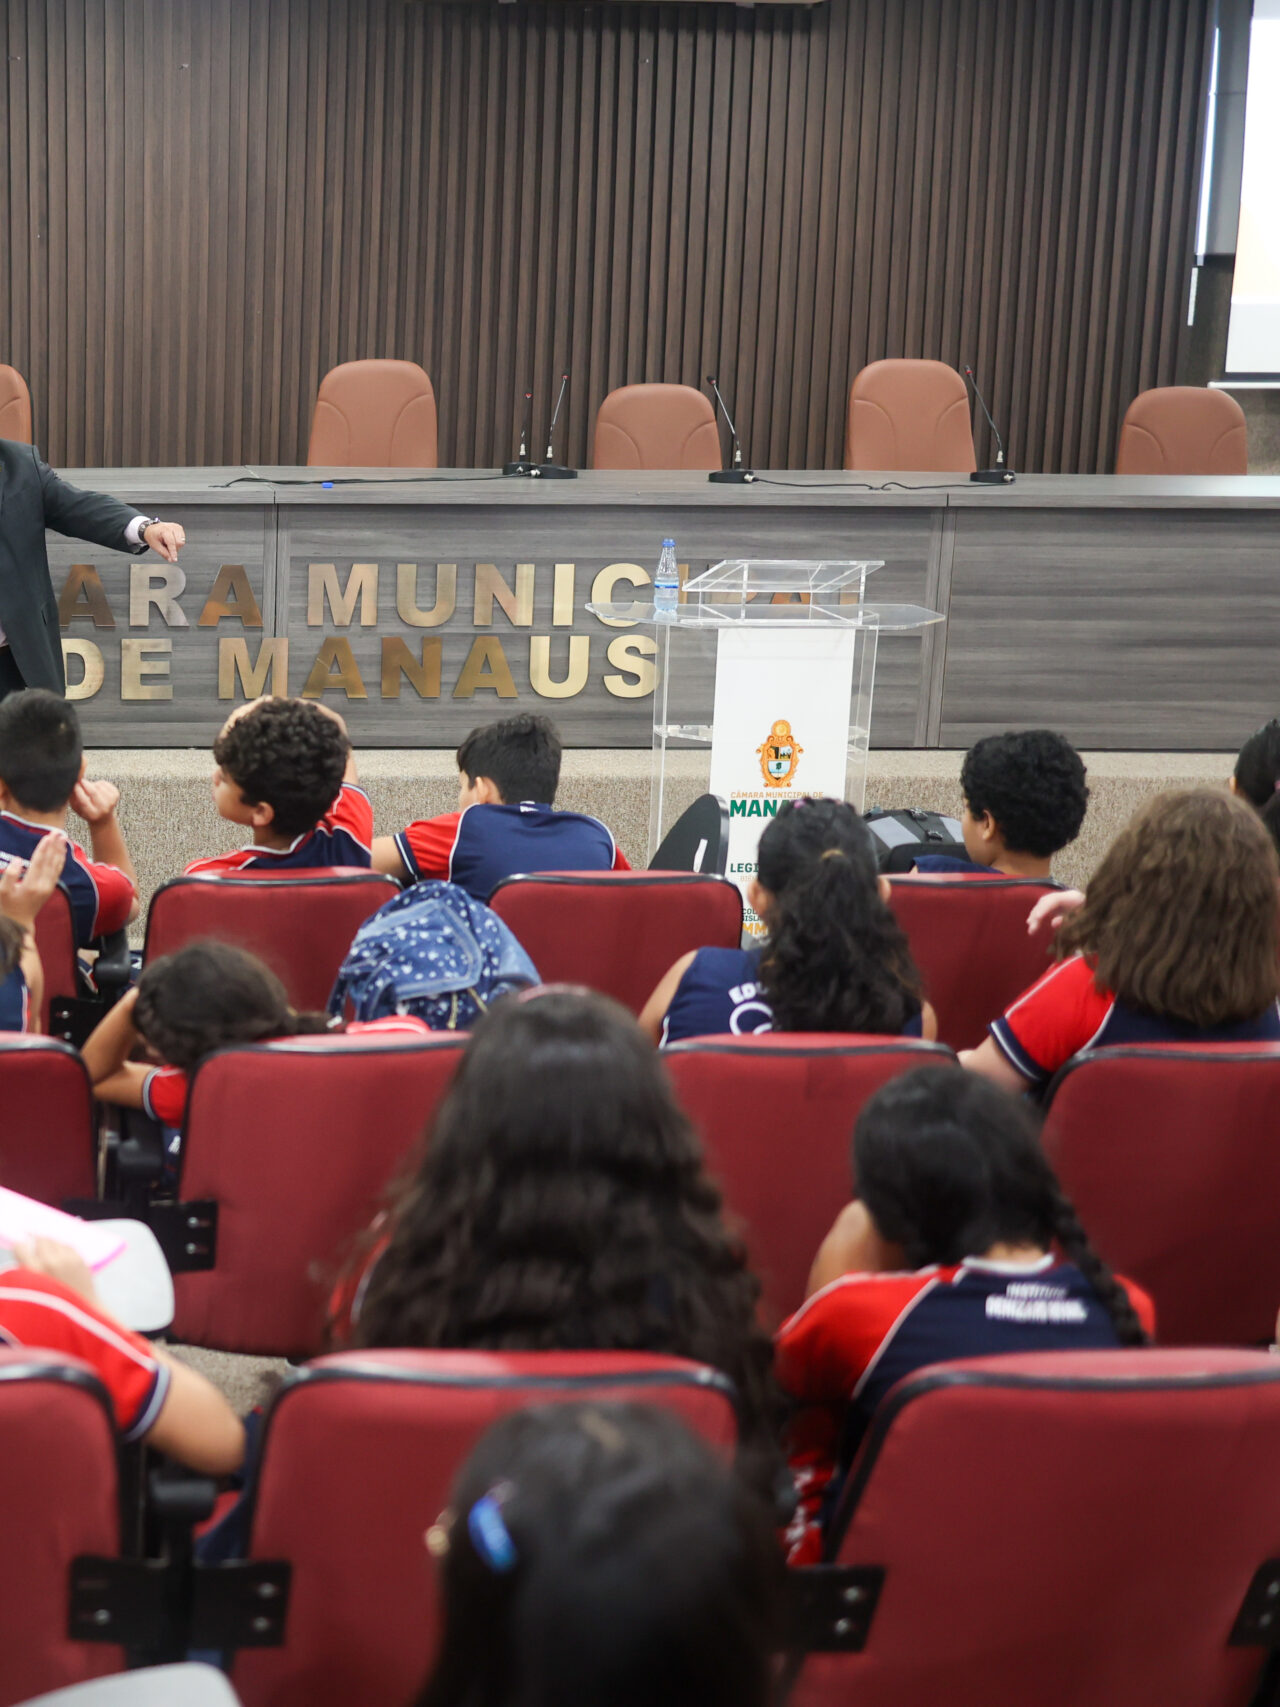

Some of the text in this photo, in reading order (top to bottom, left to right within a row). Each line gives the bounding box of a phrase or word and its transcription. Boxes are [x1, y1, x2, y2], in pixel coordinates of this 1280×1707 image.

[64, 634, 660, 701] DE MANAUS
[730, 789, 765, 799] CÂMARA
[765, 791, 811, 799] MUNICIPAL
